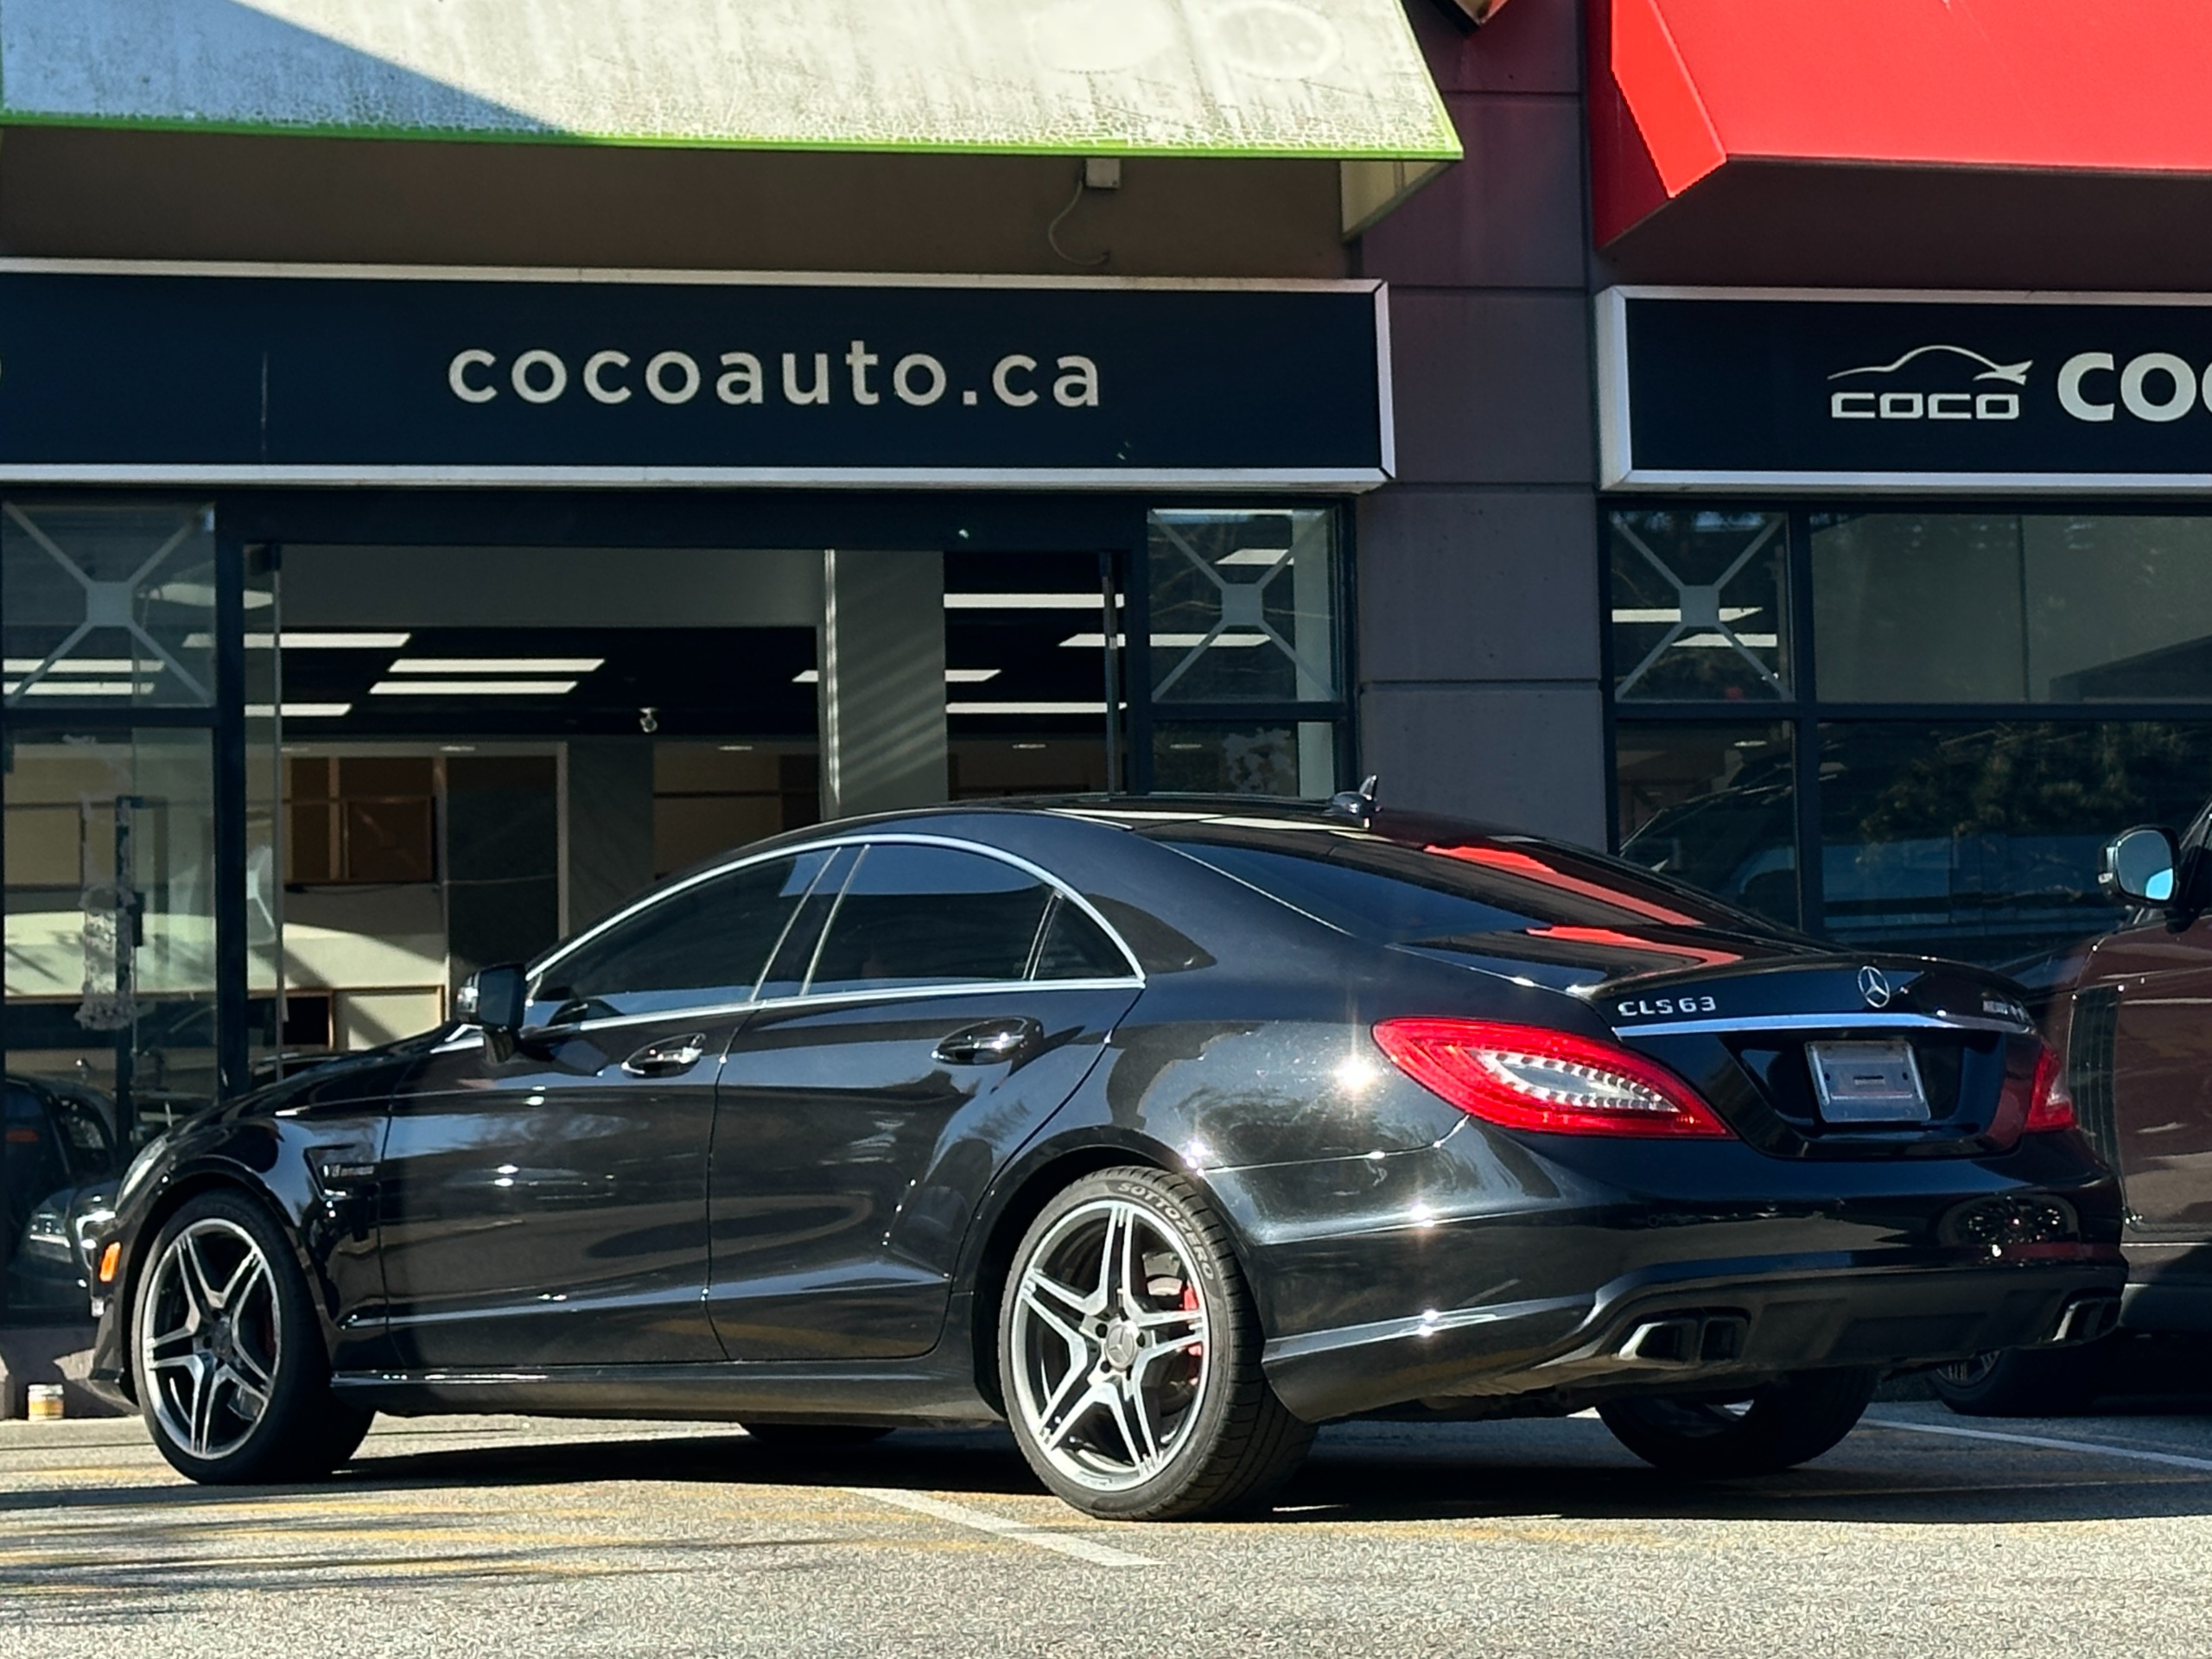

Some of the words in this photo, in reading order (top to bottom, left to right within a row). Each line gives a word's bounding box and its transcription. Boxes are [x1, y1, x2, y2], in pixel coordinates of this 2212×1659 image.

[448, 340, 1099, 407] cocoauto.ca
[1831, 392, 2019, 420] COCO
[2057, 352, 2212, 423] CO
[1117, 1182, 1214, 1280] SOTTOZERO
